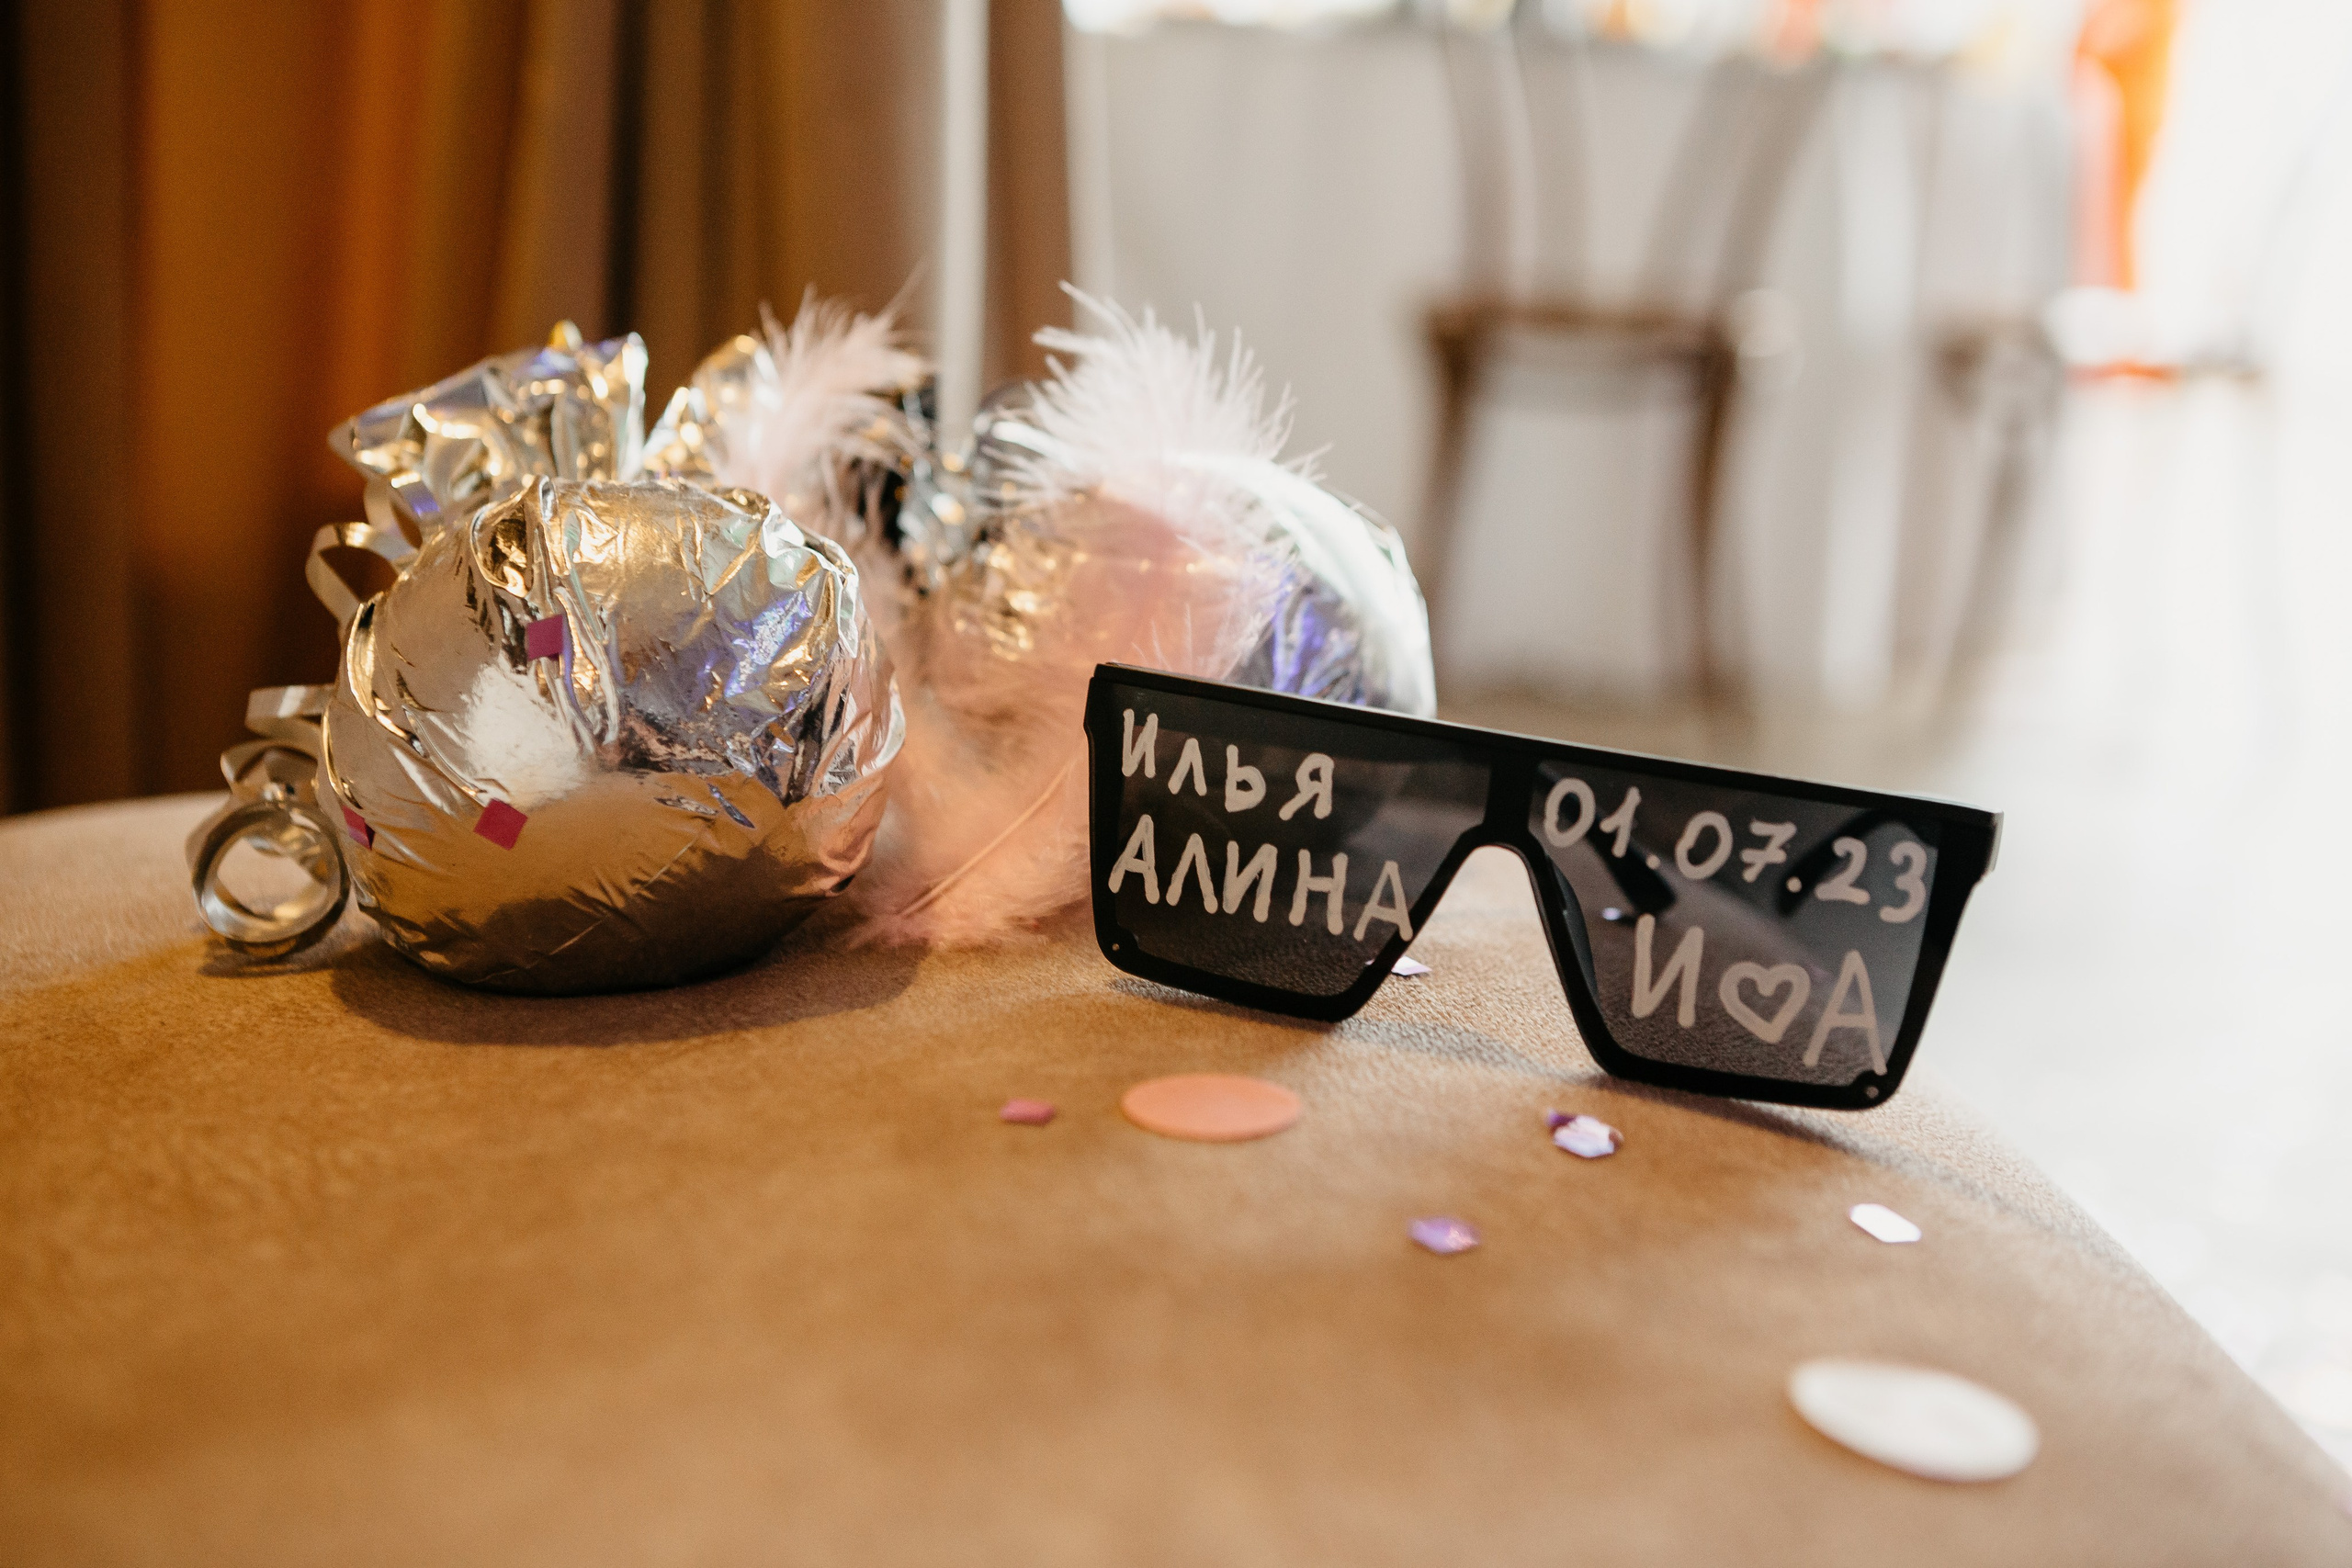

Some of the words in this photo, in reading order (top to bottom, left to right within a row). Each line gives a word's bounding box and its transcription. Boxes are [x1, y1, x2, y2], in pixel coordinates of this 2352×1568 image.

[1122, 708, 1334, 820] ИЛЬЯ
[1108, 814, 1413, 942] АЛИНА
[1544, 777, 1927, 923] 01.07.23
